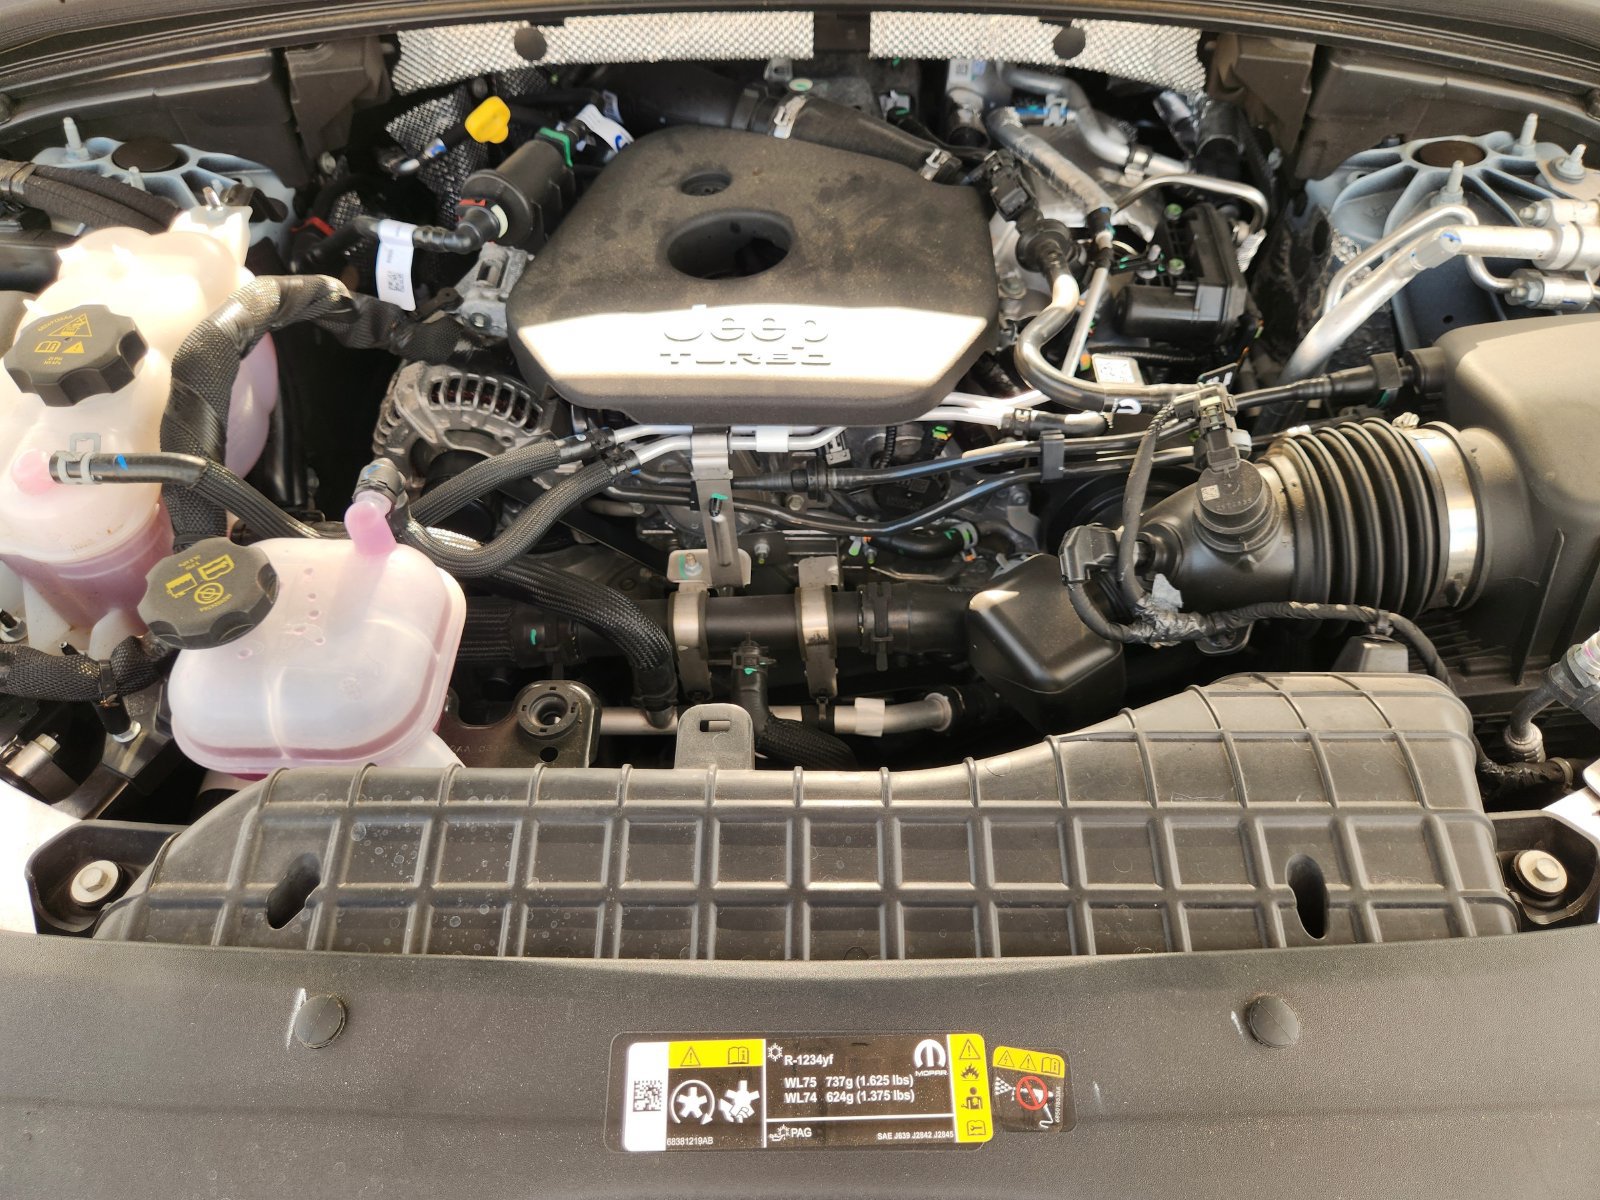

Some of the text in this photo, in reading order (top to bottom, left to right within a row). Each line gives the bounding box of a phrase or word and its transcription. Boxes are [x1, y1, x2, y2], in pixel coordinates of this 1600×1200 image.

[664, 304, 829, 349] Jeep
[659, 352, 831, 366] TURBO
[784, 1054, 834, 1068] R-1234yf
[784, 1074, 914, 1088] WL75 737g (1.625 lbs)
[784, 1089, 915, 1104] WL74 624g (1.375 lbs)
[791, 1127, 812, 1138] PAG
[877, 1130, 954, 1140] SAE J639 J2842 J2845
[666, 1136, 714, 1146] 68381219AB
